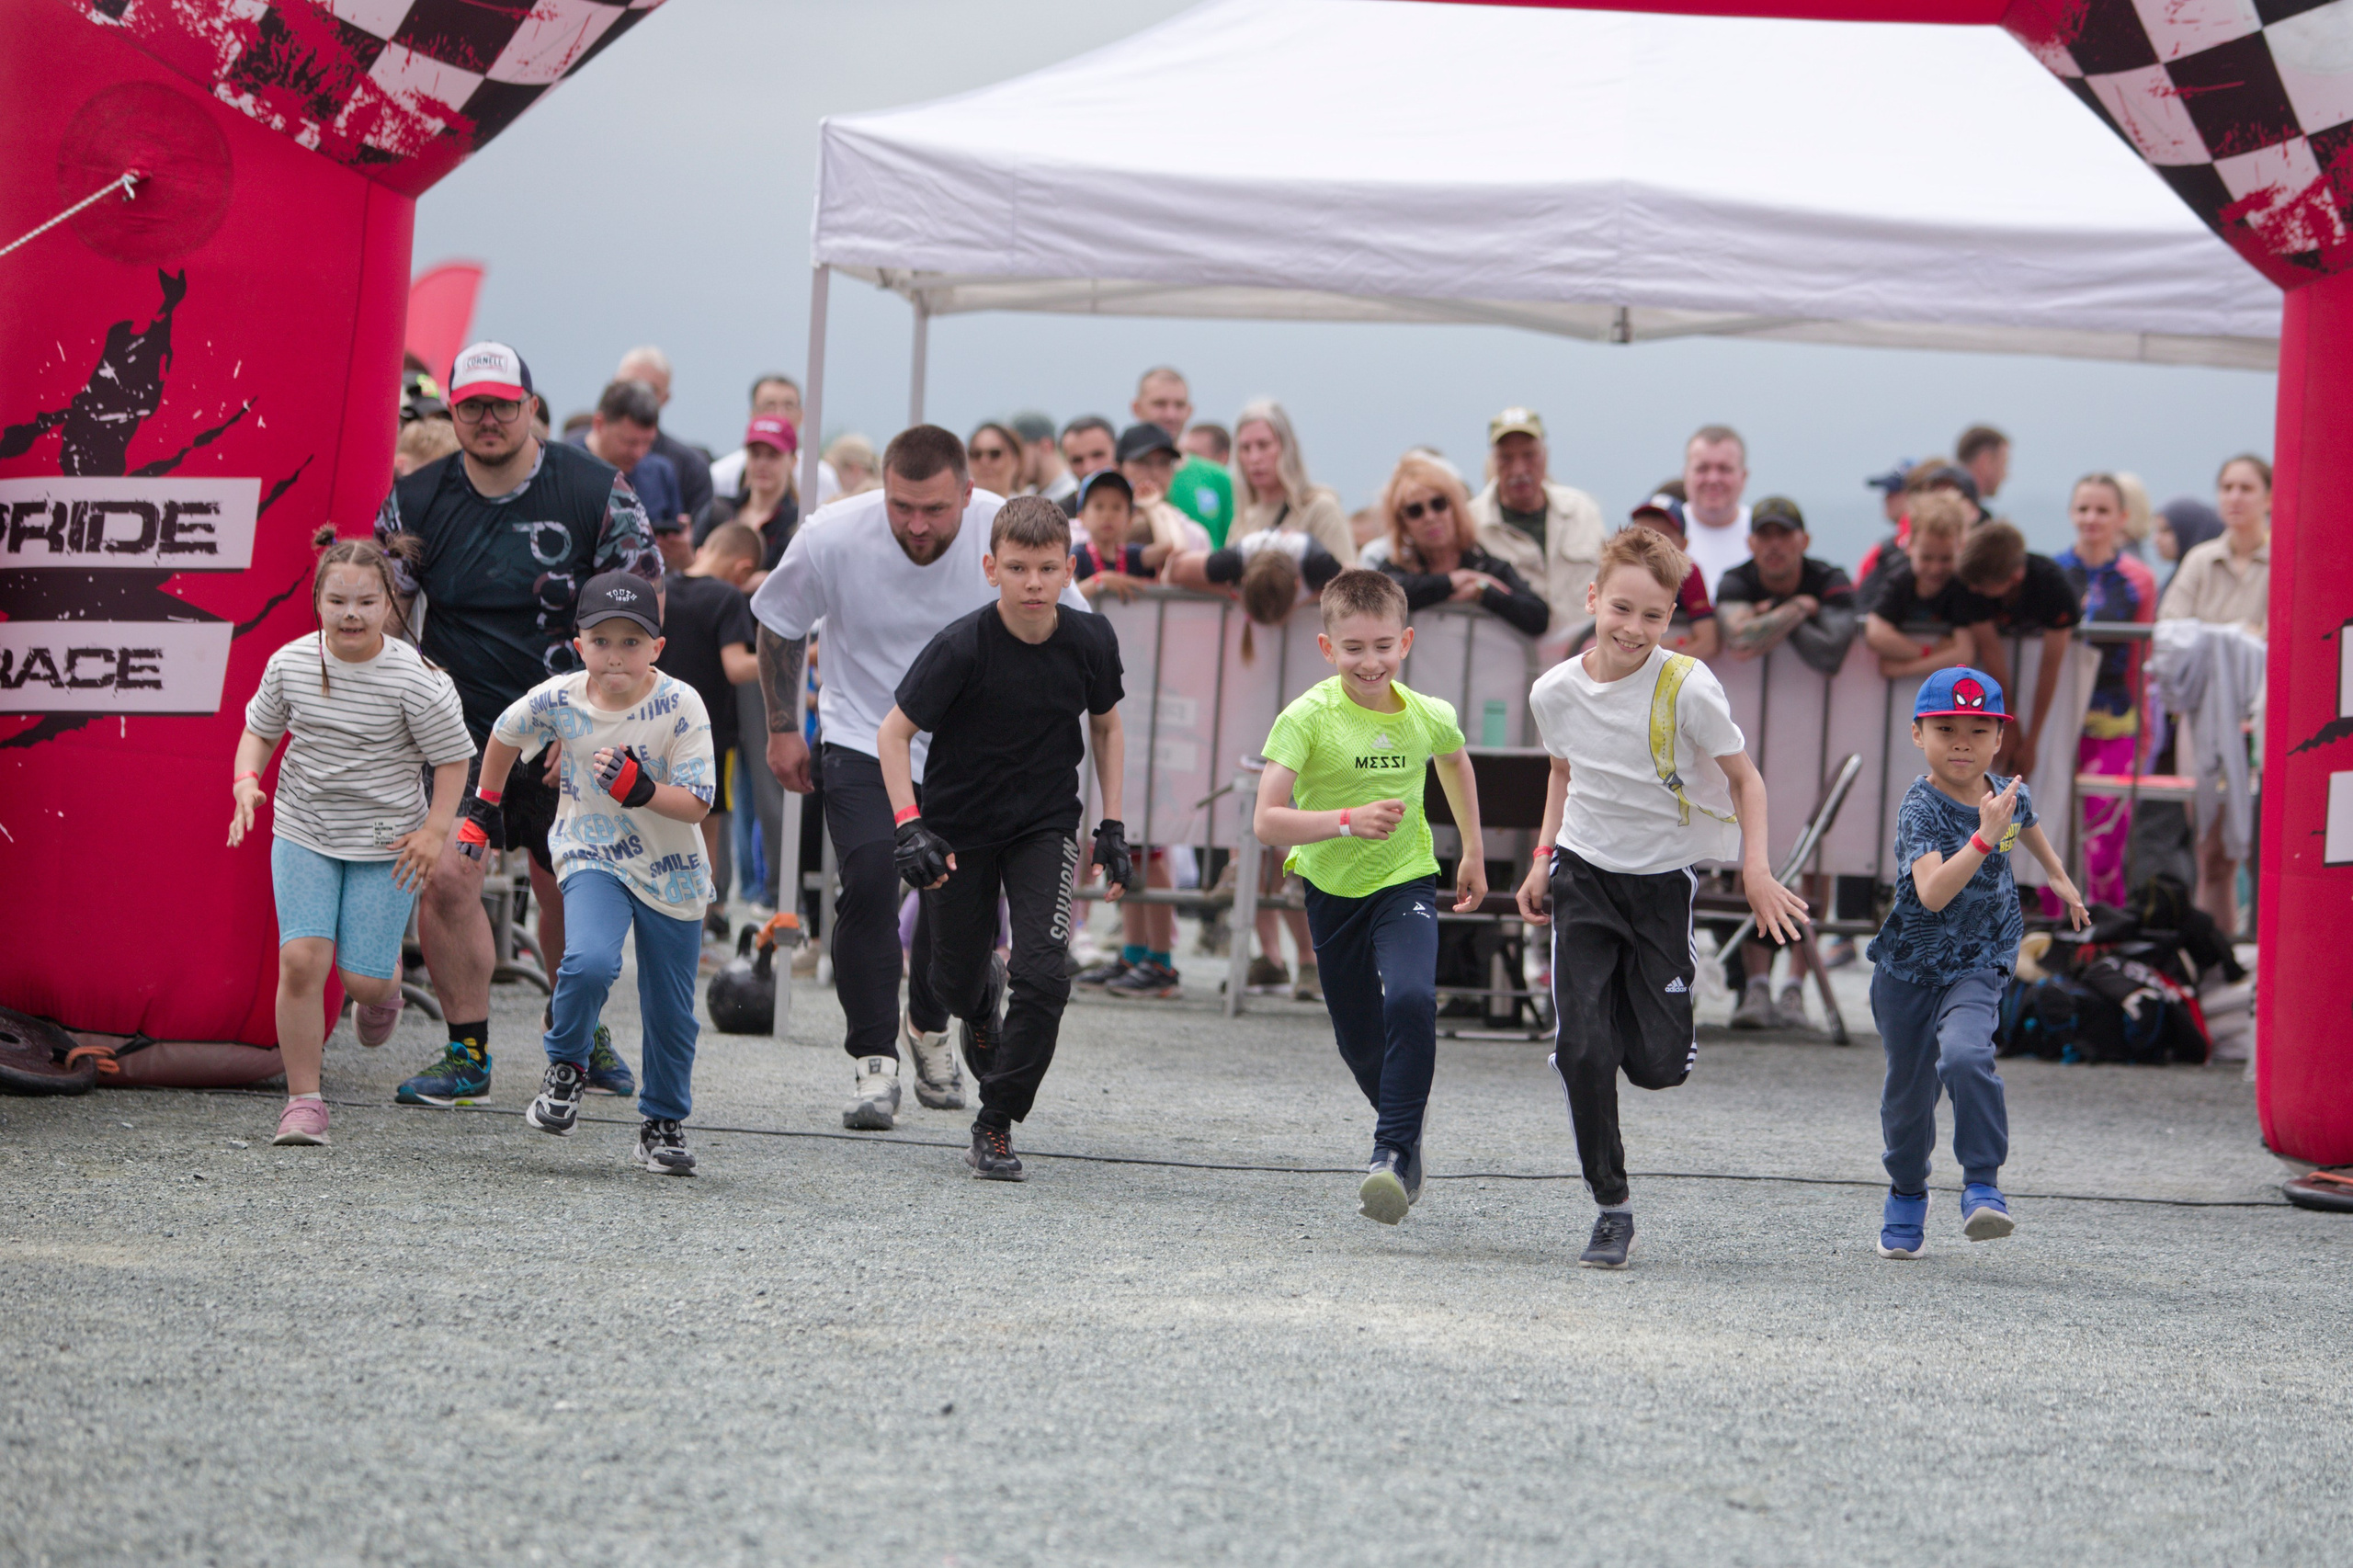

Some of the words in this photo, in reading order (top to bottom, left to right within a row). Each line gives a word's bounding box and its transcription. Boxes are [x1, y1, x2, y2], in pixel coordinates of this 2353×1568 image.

[466, 356, 504, 369] CORNELL
[0, 499, 221, 555] RIDE
[606, 588, 638, 601] YOUTH
[529, 689, 570, 715] SMILE
[1355, 756, 1405, 769] MESSI
[571, 813, 618, 844] KEEP
[650, 853, 700, 879] SMILE
